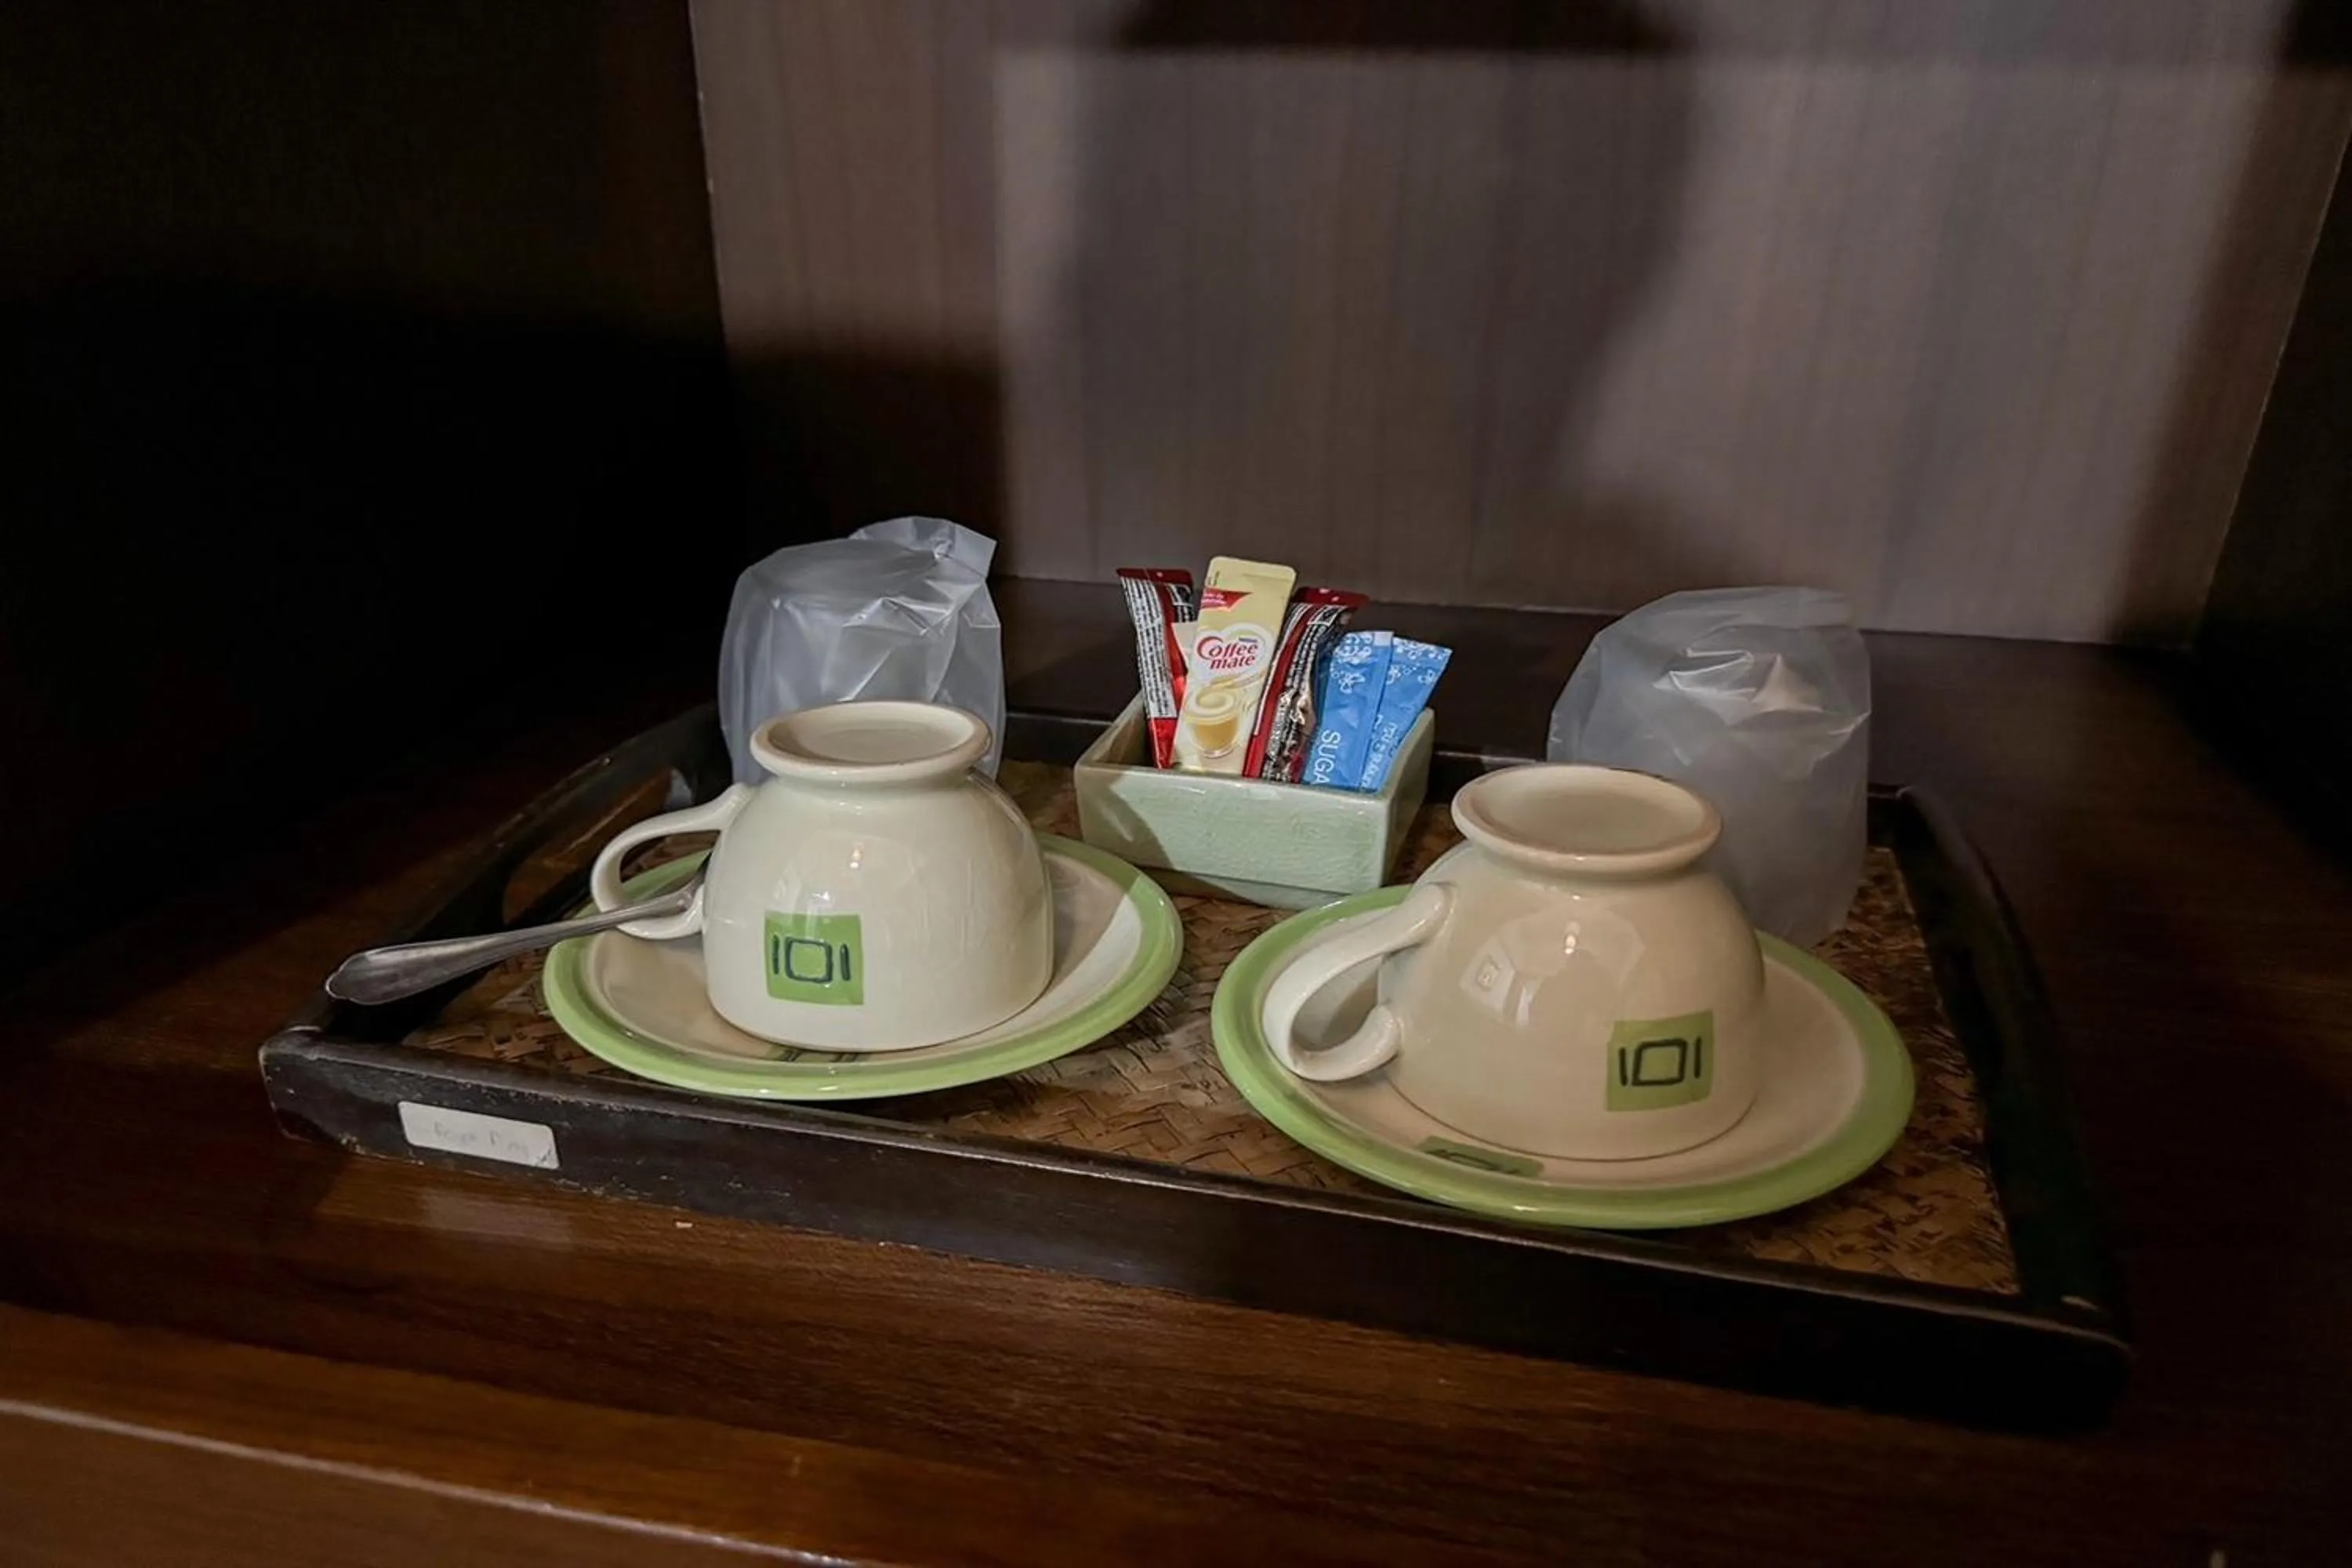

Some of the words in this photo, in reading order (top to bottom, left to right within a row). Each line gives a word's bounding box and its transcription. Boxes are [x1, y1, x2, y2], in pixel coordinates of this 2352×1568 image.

[1197, 636, 1258, 660] Coffee
[1210, 655, 1256, 670] mate
[1312, 729, 1341, 785] SUGA
